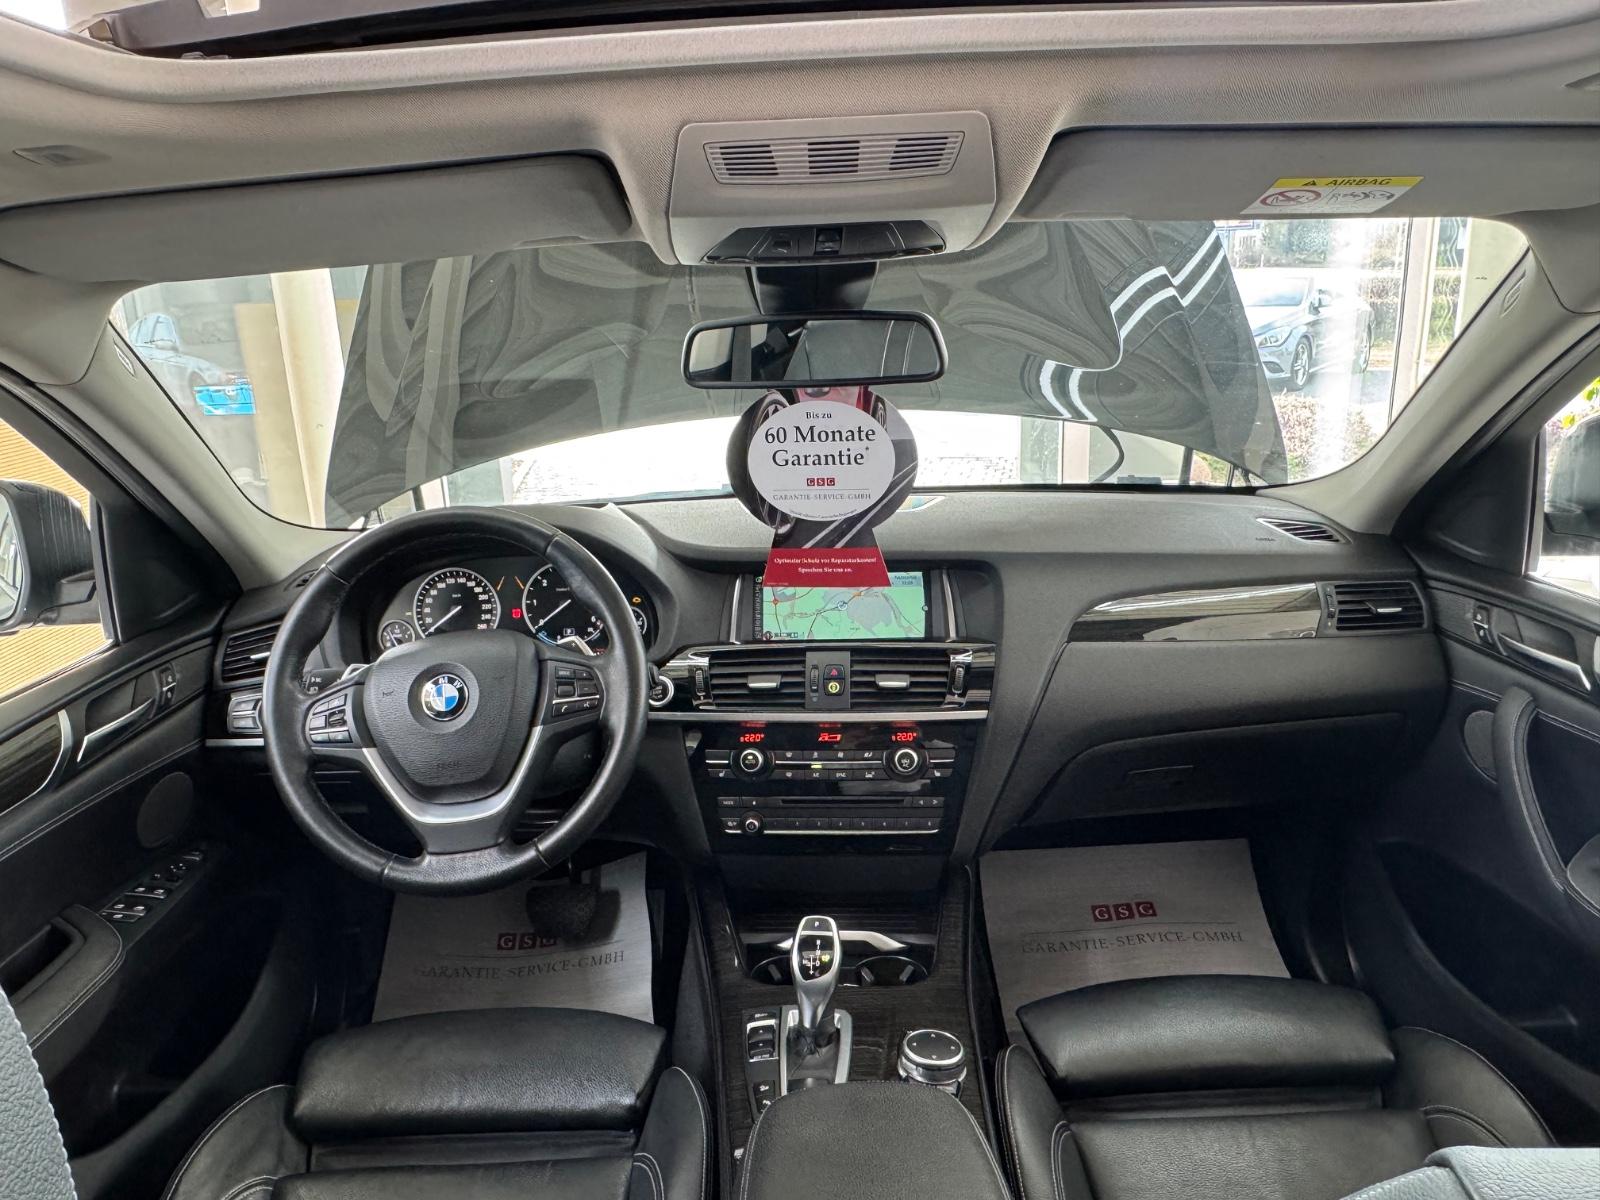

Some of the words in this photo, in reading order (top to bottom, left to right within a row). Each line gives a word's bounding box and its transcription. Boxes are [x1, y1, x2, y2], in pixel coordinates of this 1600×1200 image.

[1325, 178, 1392, 186] AIRBAG
[806, 411, 820, 419] Bis
[764, 426, 787, 444] 60
[794, 425, 876, 443] Monate
[807, 478, 835, 486] GSG
[1091, 902, 1157, 922] GSG
[1021, 930, 1244, 954] GARANTIE-SERVICE-GMBH
